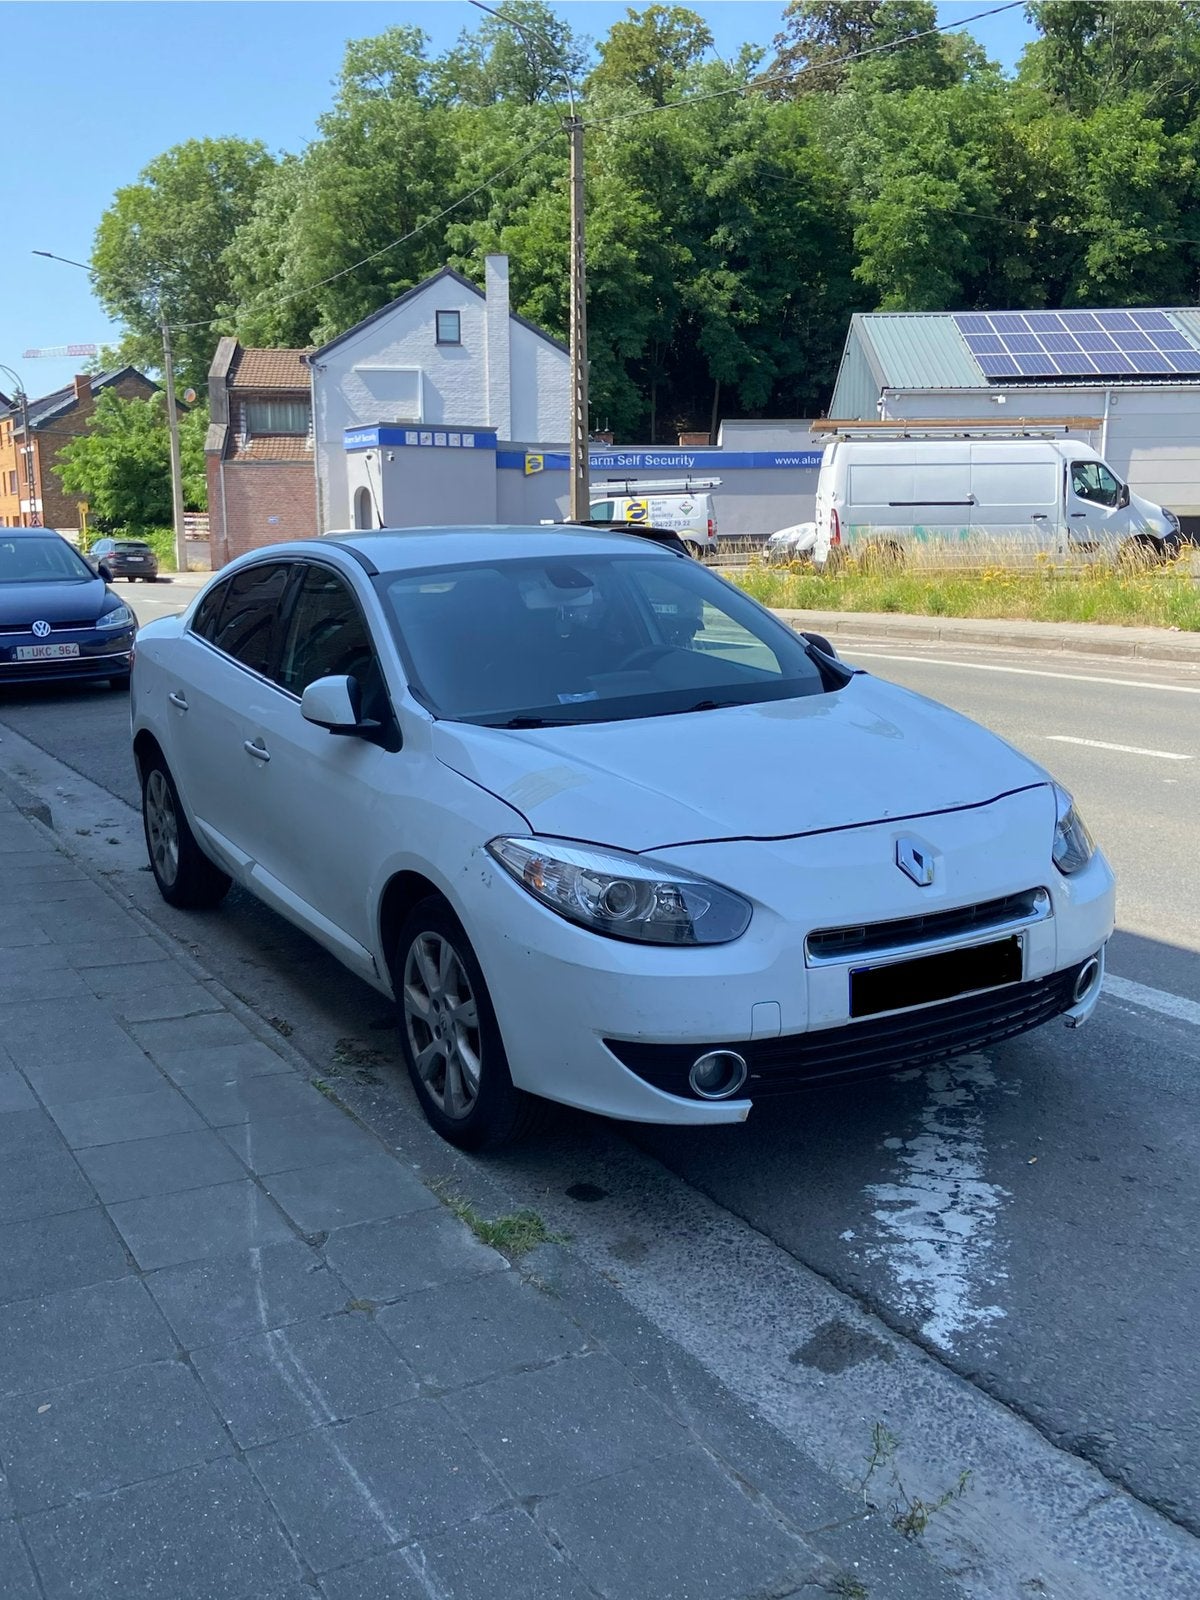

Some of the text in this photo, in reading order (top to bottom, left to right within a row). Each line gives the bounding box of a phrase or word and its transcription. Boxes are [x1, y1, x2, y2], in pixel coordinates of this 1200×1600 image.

[588, 454, 695, 468] larm Self Security
[774, 456, 823, 465] www.alar
